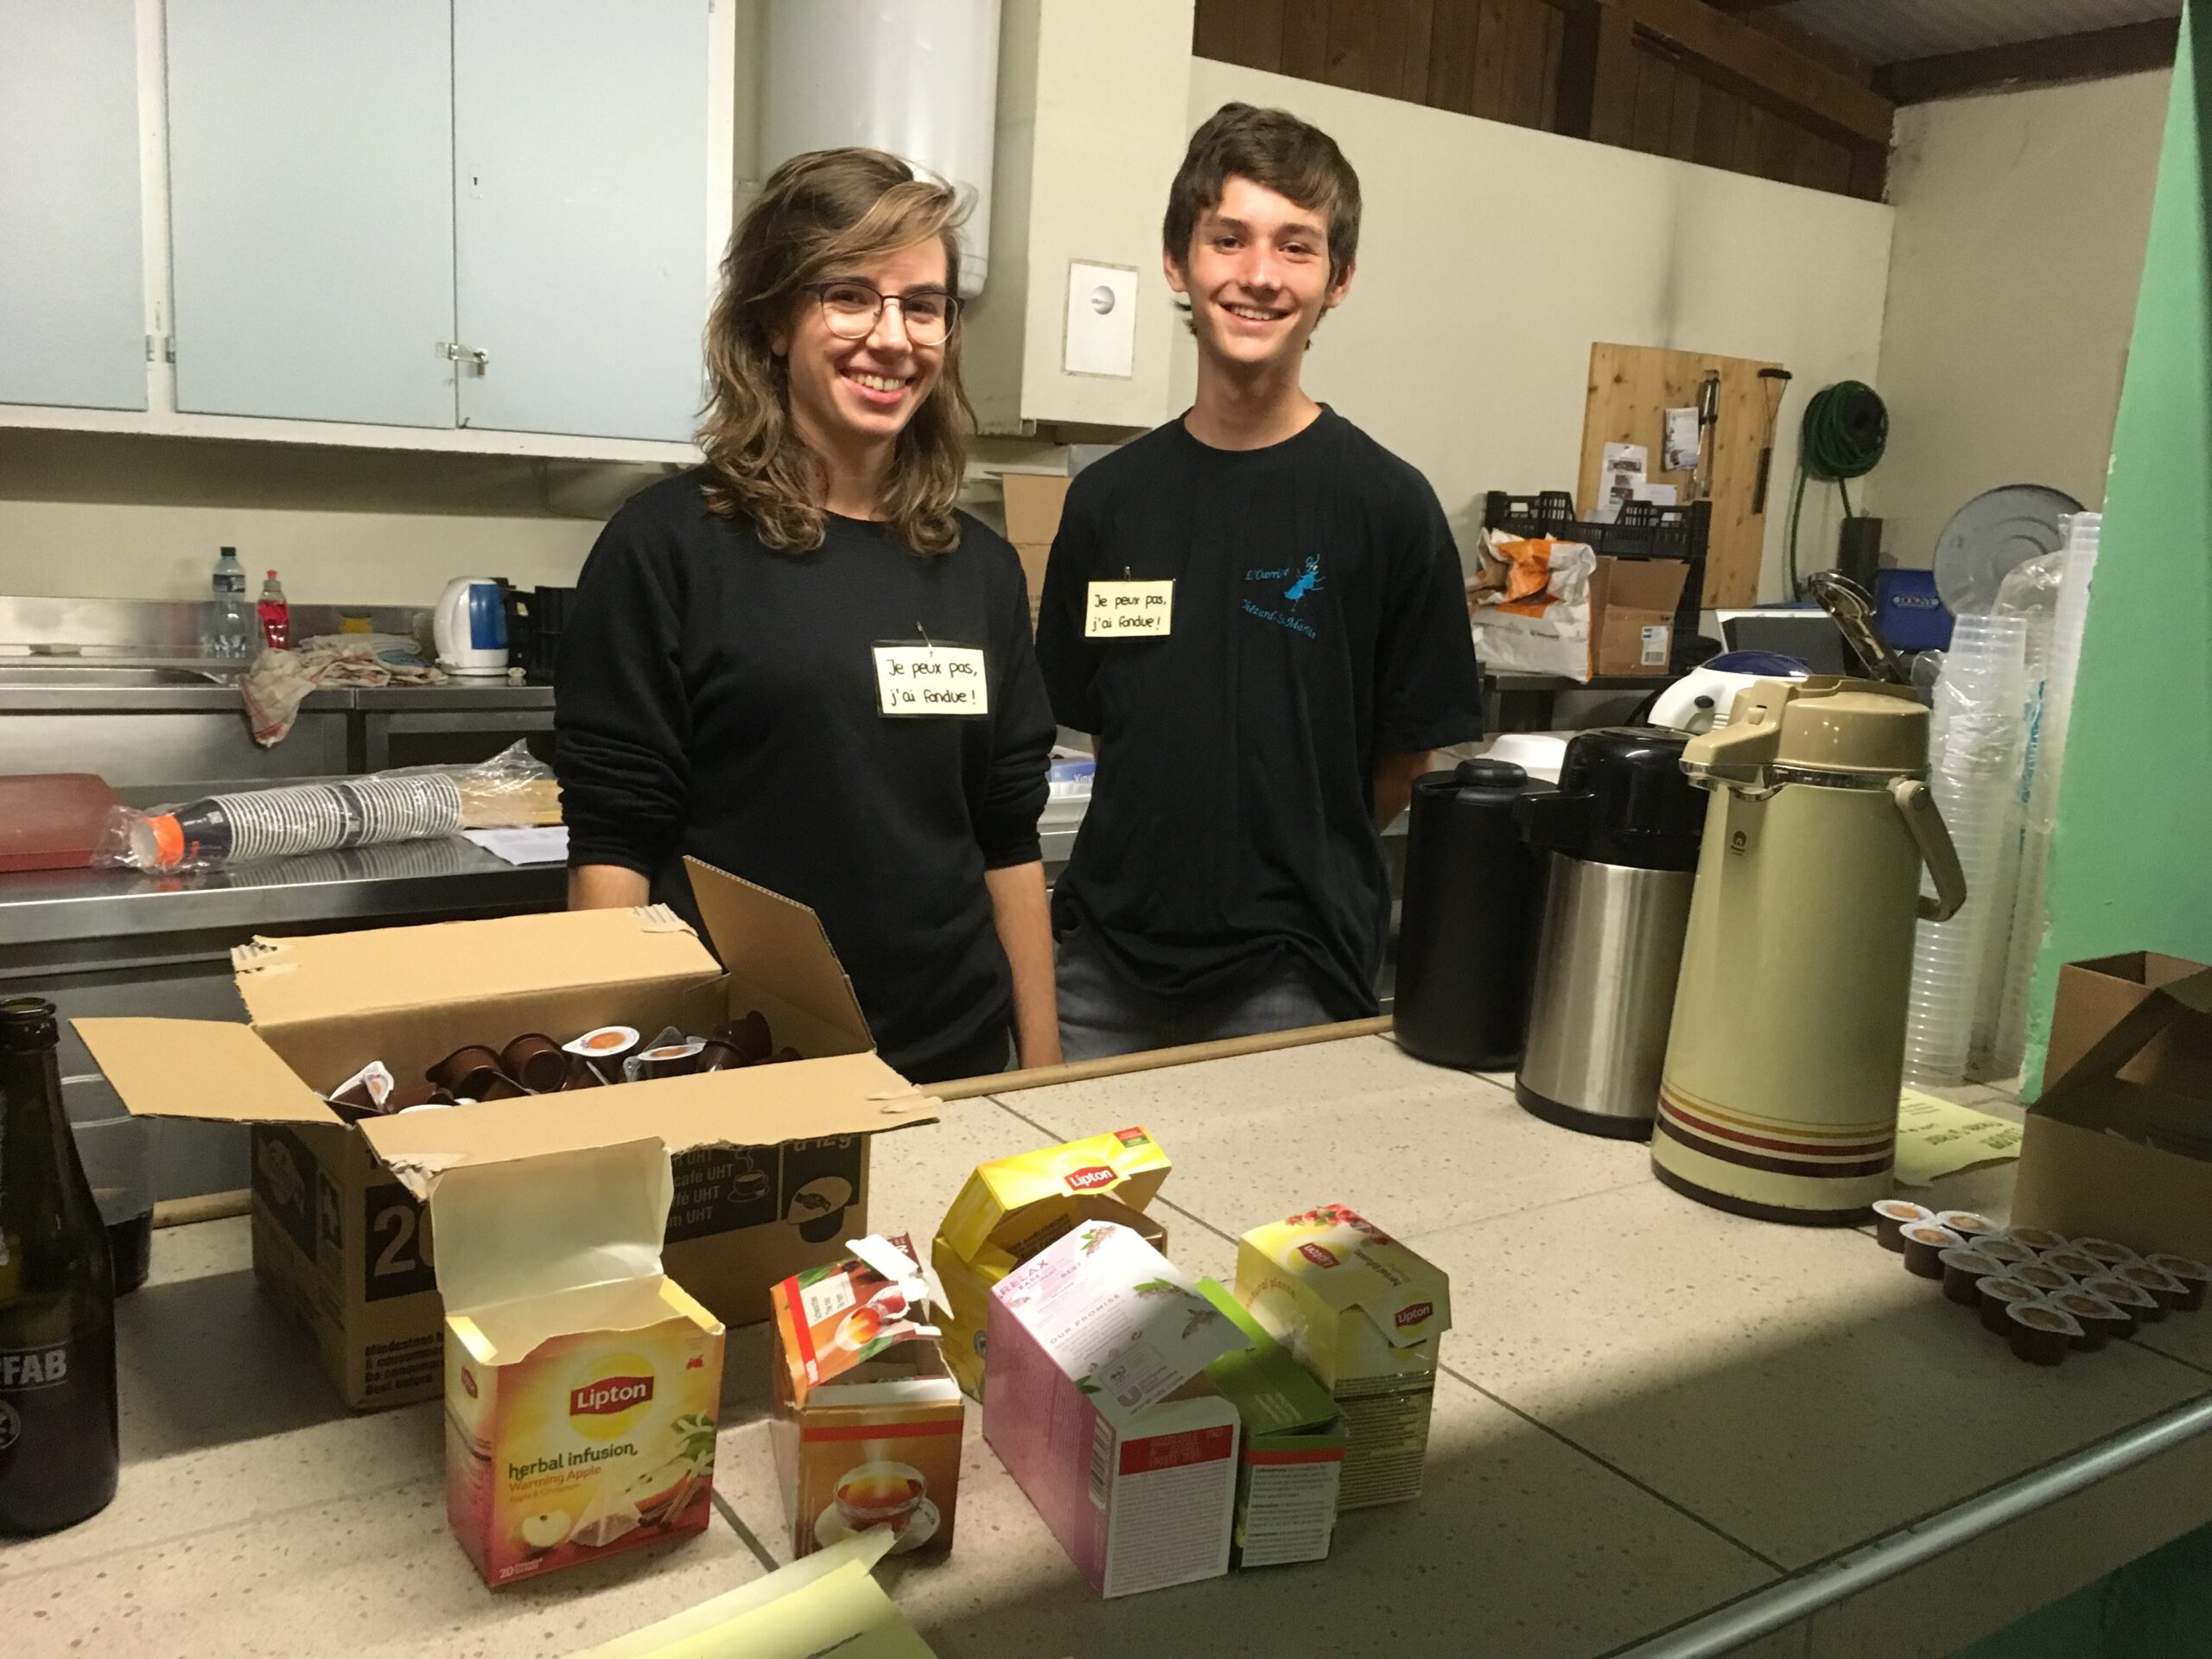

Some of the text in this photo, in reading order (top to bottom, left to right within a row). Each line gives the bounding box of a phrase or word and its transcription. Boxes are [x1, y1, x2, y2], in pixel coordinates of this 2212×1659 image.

[1095, 594, 1166, 609] Je peux pas,
[1092, 617, 1112, 632] j'ai
[886, 658, 977, 678] Je peux pas,
[890, 688, 916, 707] j'ai
[707, 1163, 734, 1181] UHT
[1069, 1169, 1113, 1188] Lipton
[693, 1185, 721, 1204] UHT
[686, 1206, 714, 1224] UHT
[1303, 1244, 1336, 1268] Lipton
[1000, 1260, 1048, 1296] RELAX
[1050, 1327, 1071, 1344] OUR
[1074, 1294, 1121, 1327] PROMISE
[1398, 1305, 1430, 1324] Lipton
[3, 1349, 67, 1385] FAB
[576, 1383, 647, 1409] Lipton
[509, 1443, 638, 1480] herbal infusion
[509, 1465, 601, 1492] Warming Apple
